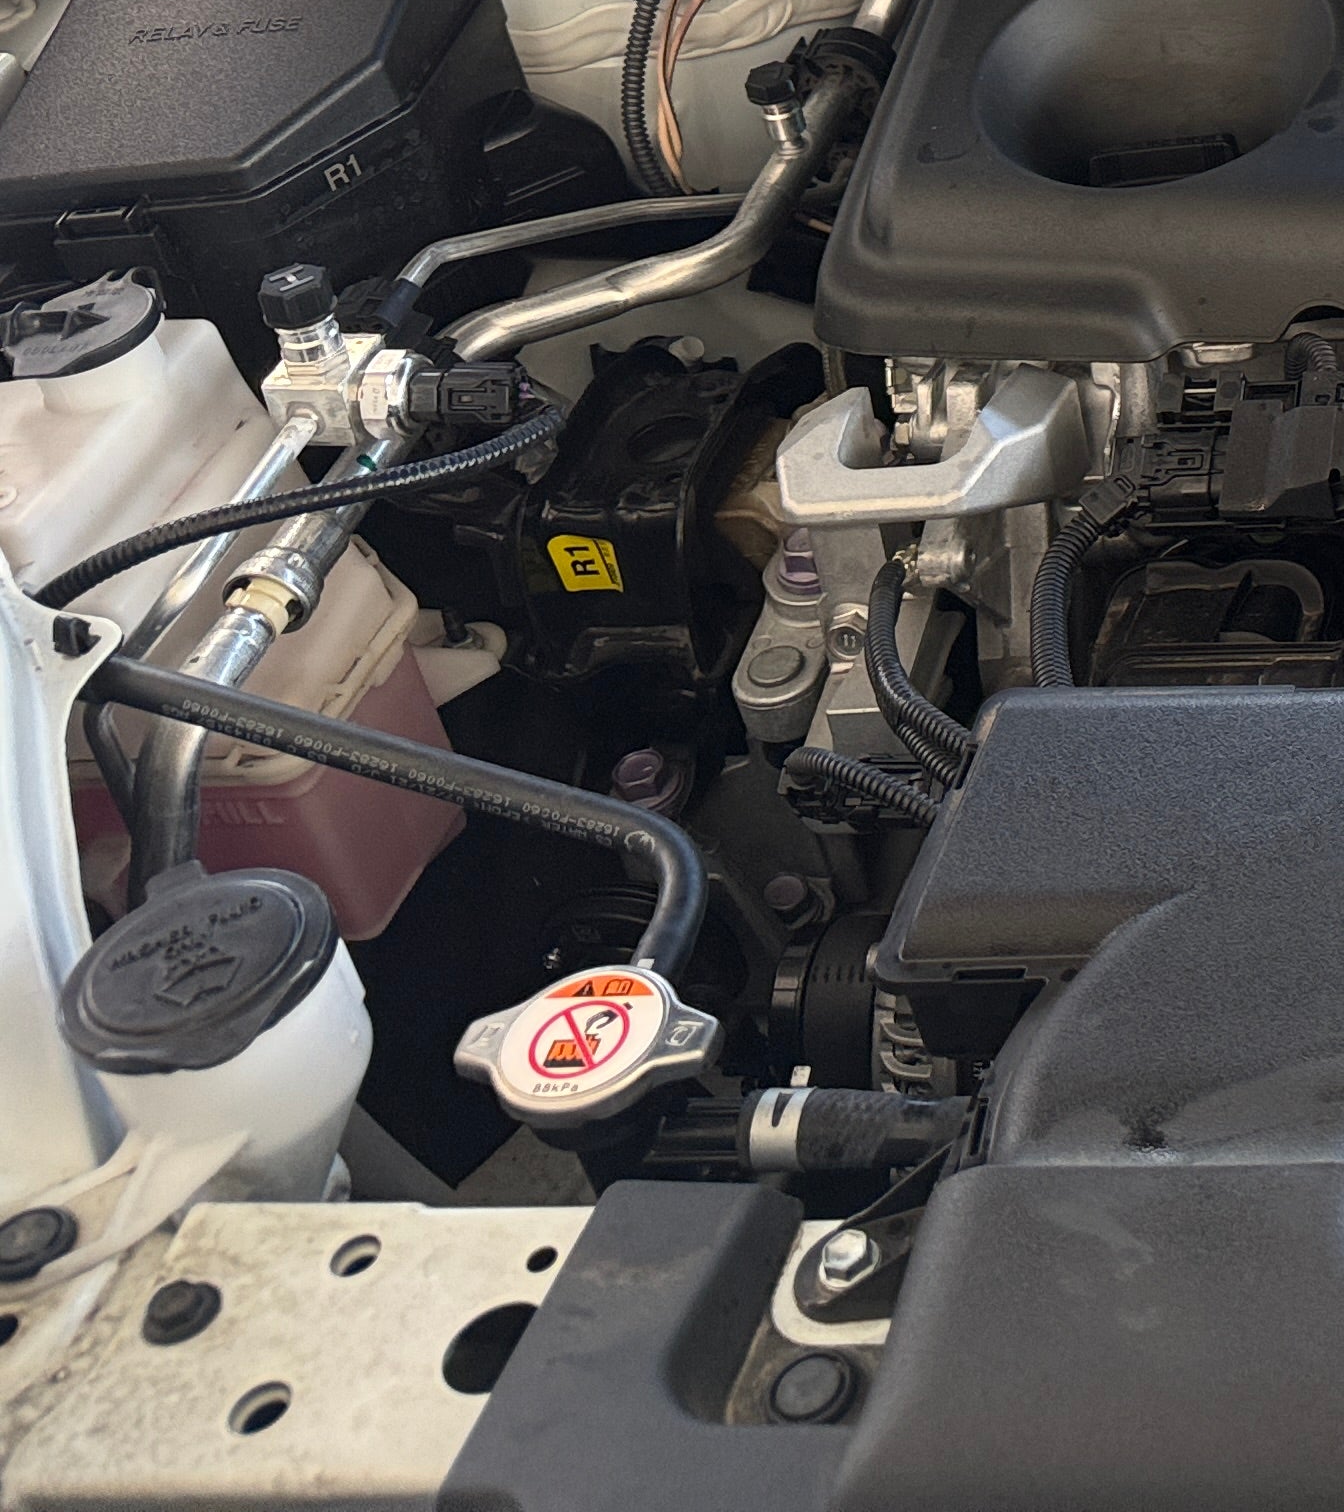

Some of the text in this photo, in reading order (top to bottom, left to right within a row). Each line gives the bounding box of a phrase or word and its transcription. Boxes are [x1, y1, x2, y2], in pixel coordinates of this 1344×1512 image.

[128, 22, 209, 45] RELAY
[236, 17, 303, 36] FUSE
[323, 153, 362, 192] R1
[564, 545, 600, 576] R1
[292, 732, 398, 772] 16283-F0060
[532, 1082, 579, 1094] 88kPa
